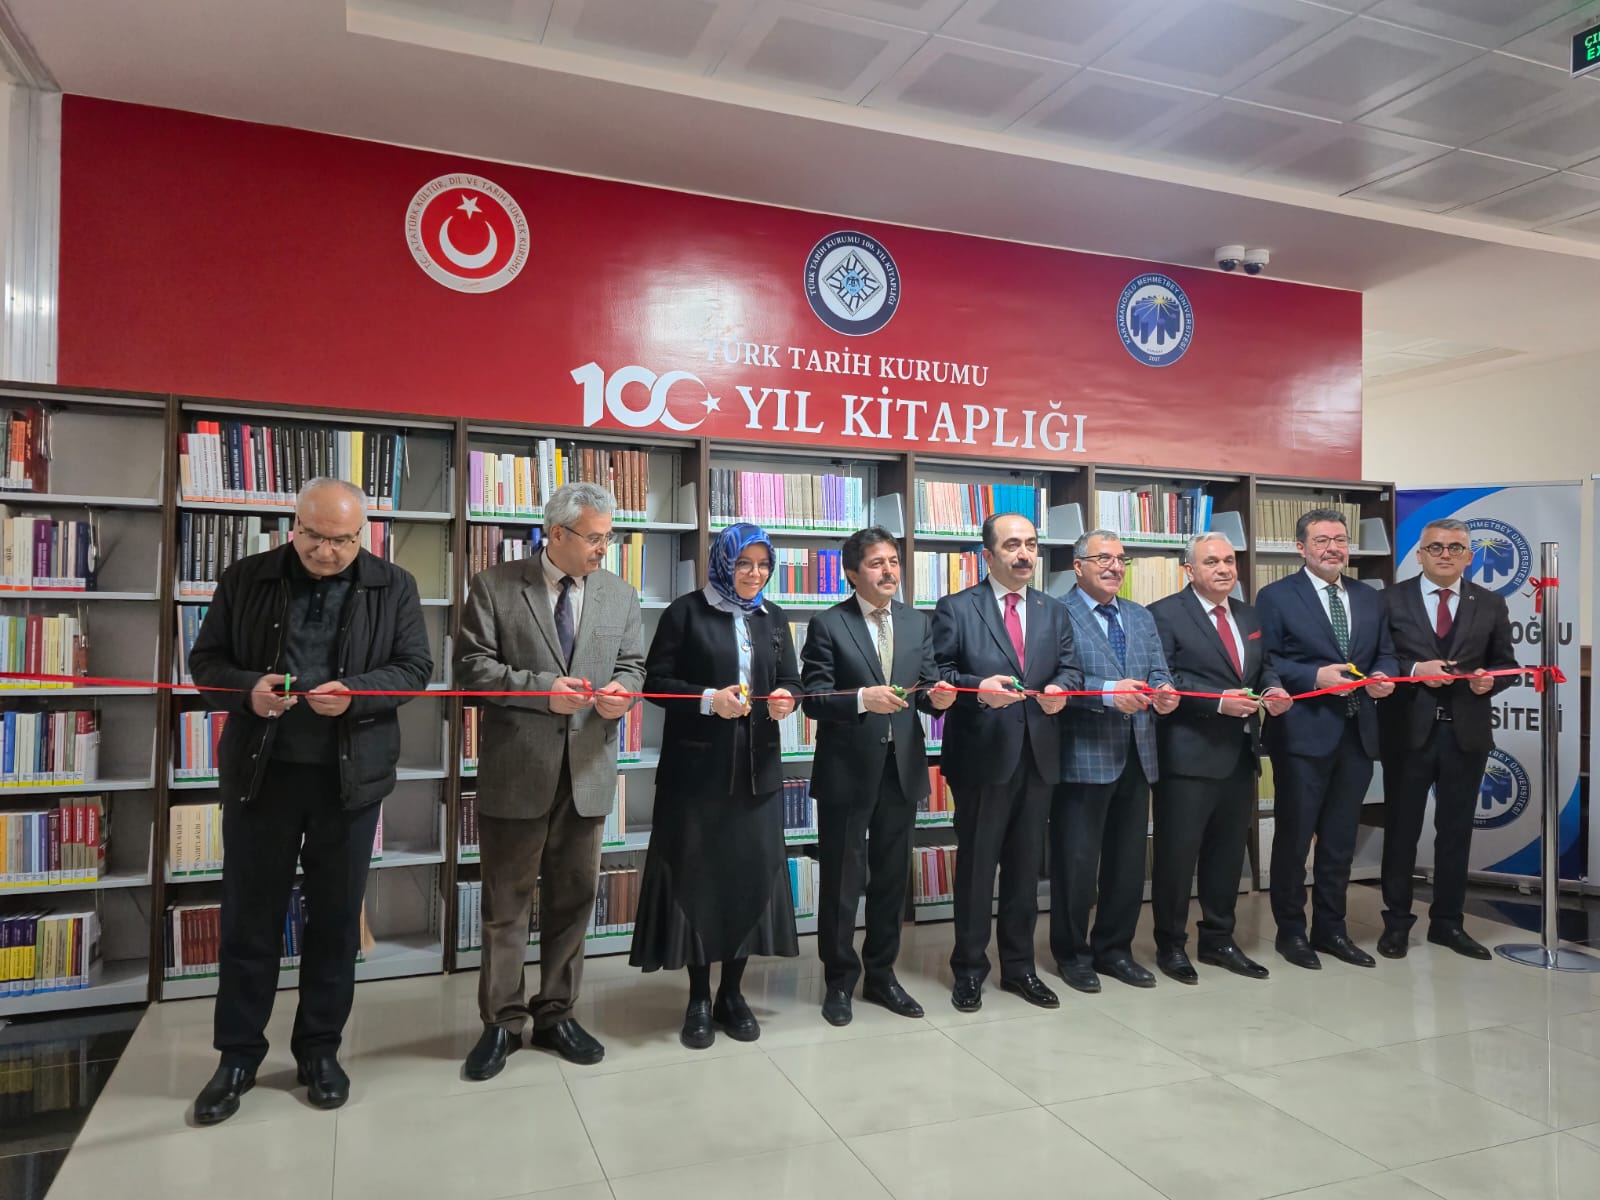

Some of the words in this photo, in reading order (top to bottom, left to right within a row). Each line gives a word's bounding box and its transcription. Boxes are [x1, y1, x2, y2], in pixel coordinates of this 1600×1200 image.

[1585, 31, 1600, 49] ÇI
[466, 177, 478, 186] VE
[482, 181, 506, 202] TARİH
[408, 208, 421, 252] ATATÜRK
[507, 201, 527, 234] YÜKSEK
[826, 235, 861, 249] KURUMU
[508, 237, 527, 275] KURUMU
[810, 245, 828, 270] TARİH
[876, 248, 887, 263] YIL
[807, 271, 817, 296] TÜRK
[884, 262, 897, 306] KİTAPLIĞI
[1137, 276, 1180, 295] MEHMETBEY
[703, 335, 782, 368] TÜRK
[788, 346, 872, 377] TARİH
[878, 356, 989, 387] KURUMU
[570, 361, 708, 432] 100
[735, 385, 825, 434] YIL
[840, 386, 1088, 453] KİTAPLIĞI
[1510, 615, 1573, 646] OĞU
[1490, 701, 1562, 733] SİTEİ
[1489, 750, 1510, 763] BEY
